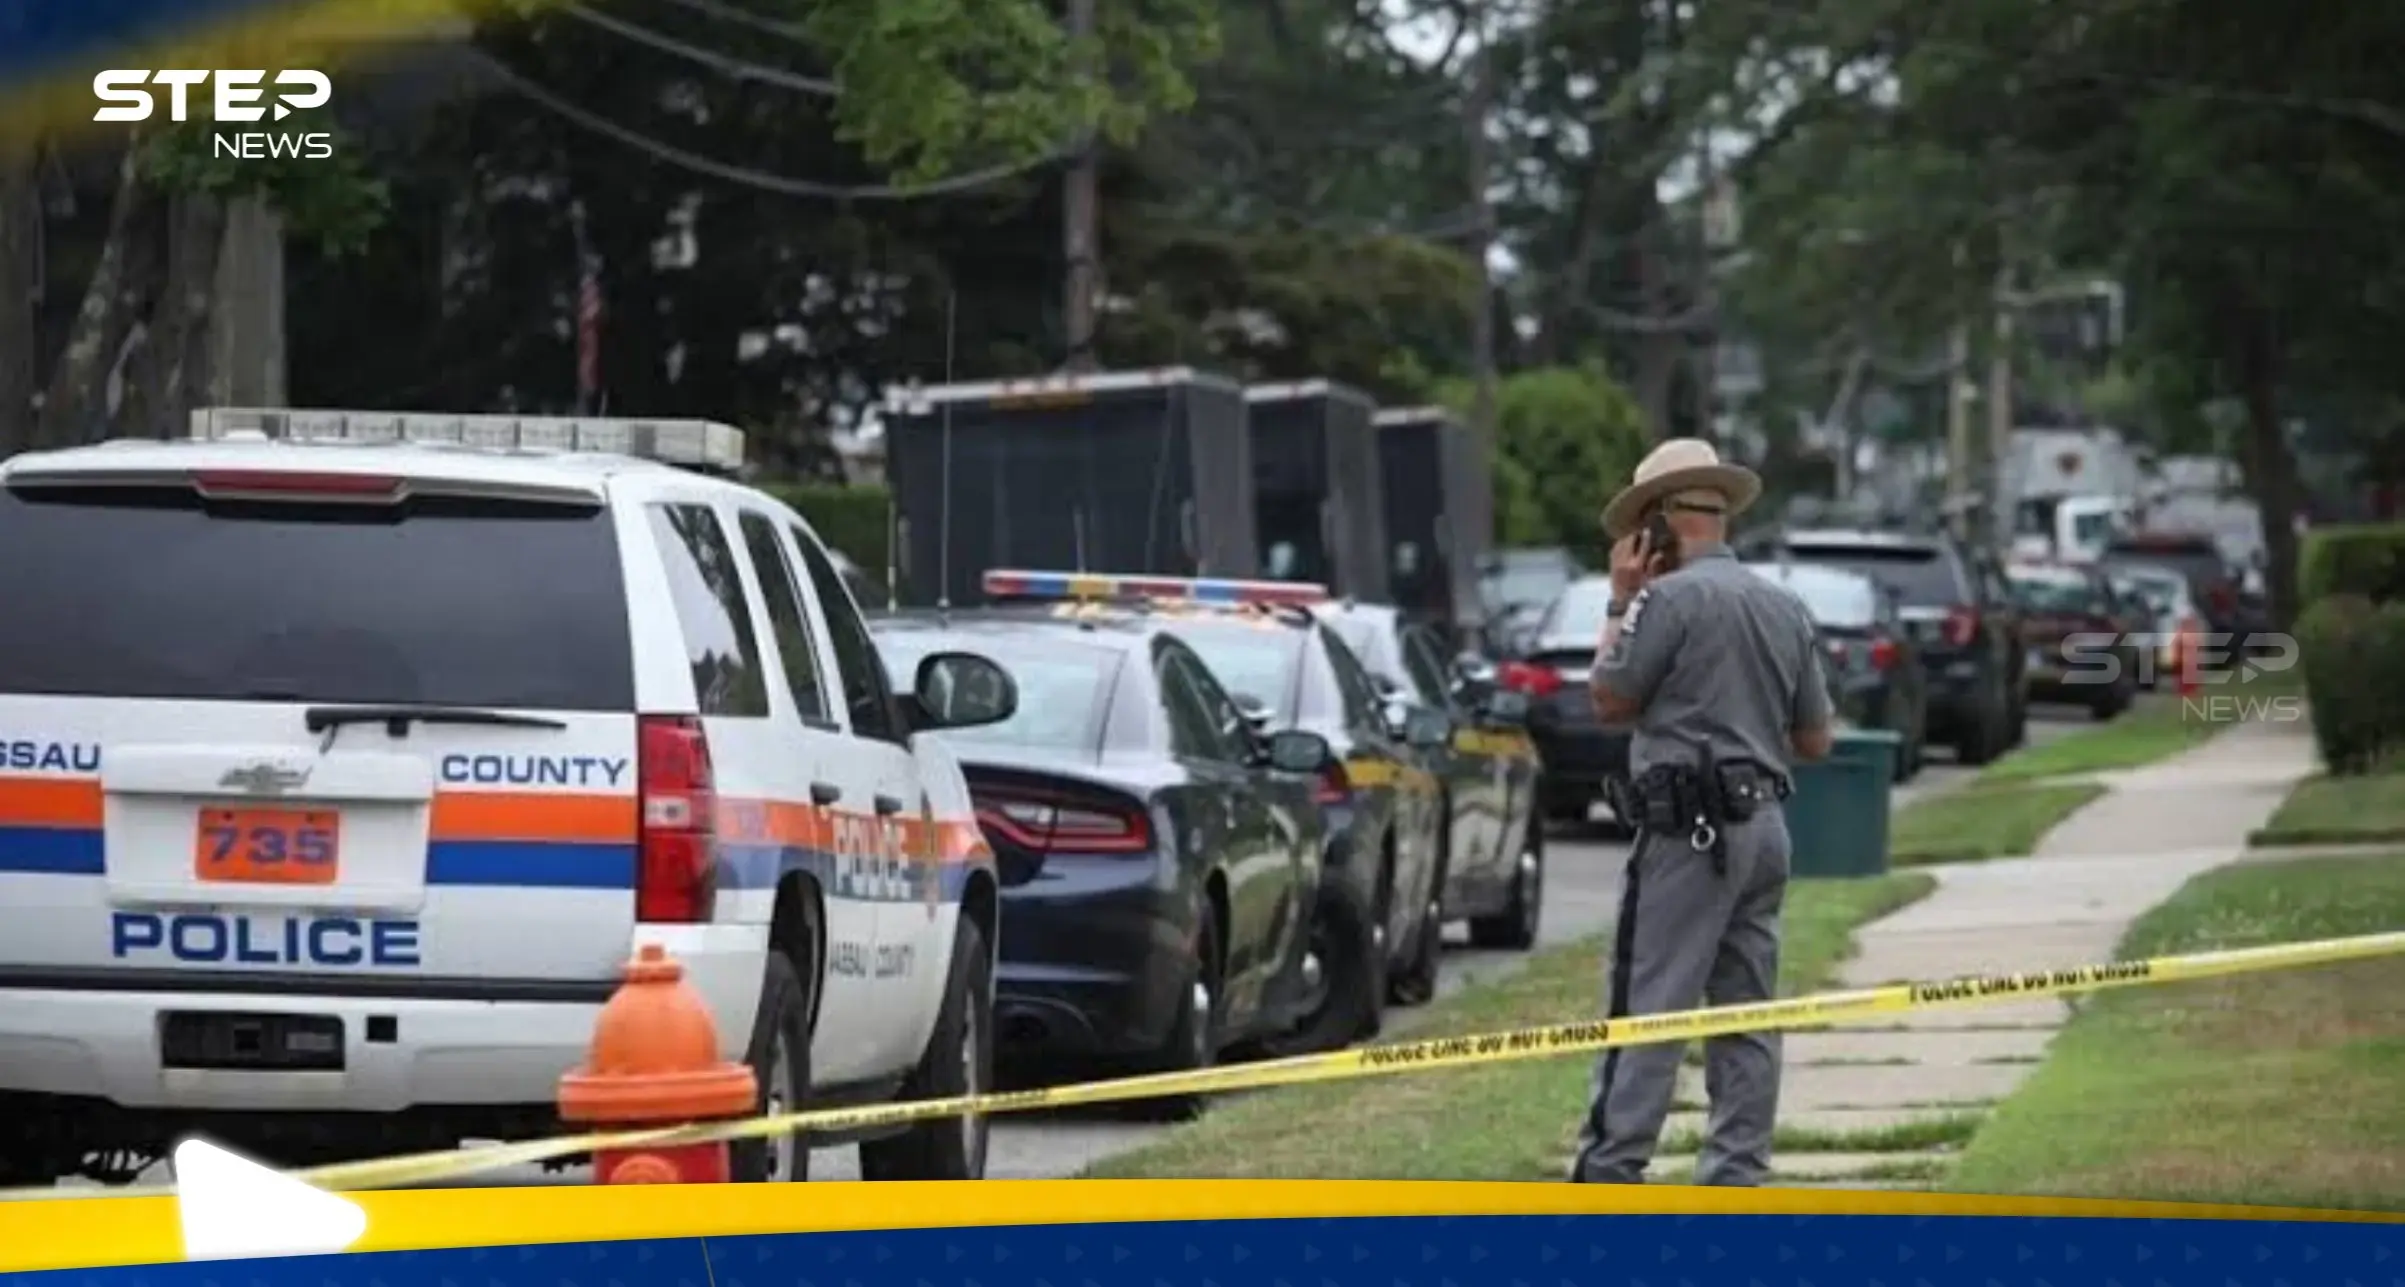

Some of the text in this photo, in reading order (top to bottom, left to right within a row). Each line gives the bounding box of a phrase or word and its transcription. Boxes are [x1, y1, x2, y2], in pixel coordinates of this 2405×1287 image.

[0, 741, 628, 785] SAU COUNTY
[202, 825, 334, 864] 735
[113, 912, 420, 966] POLICE
